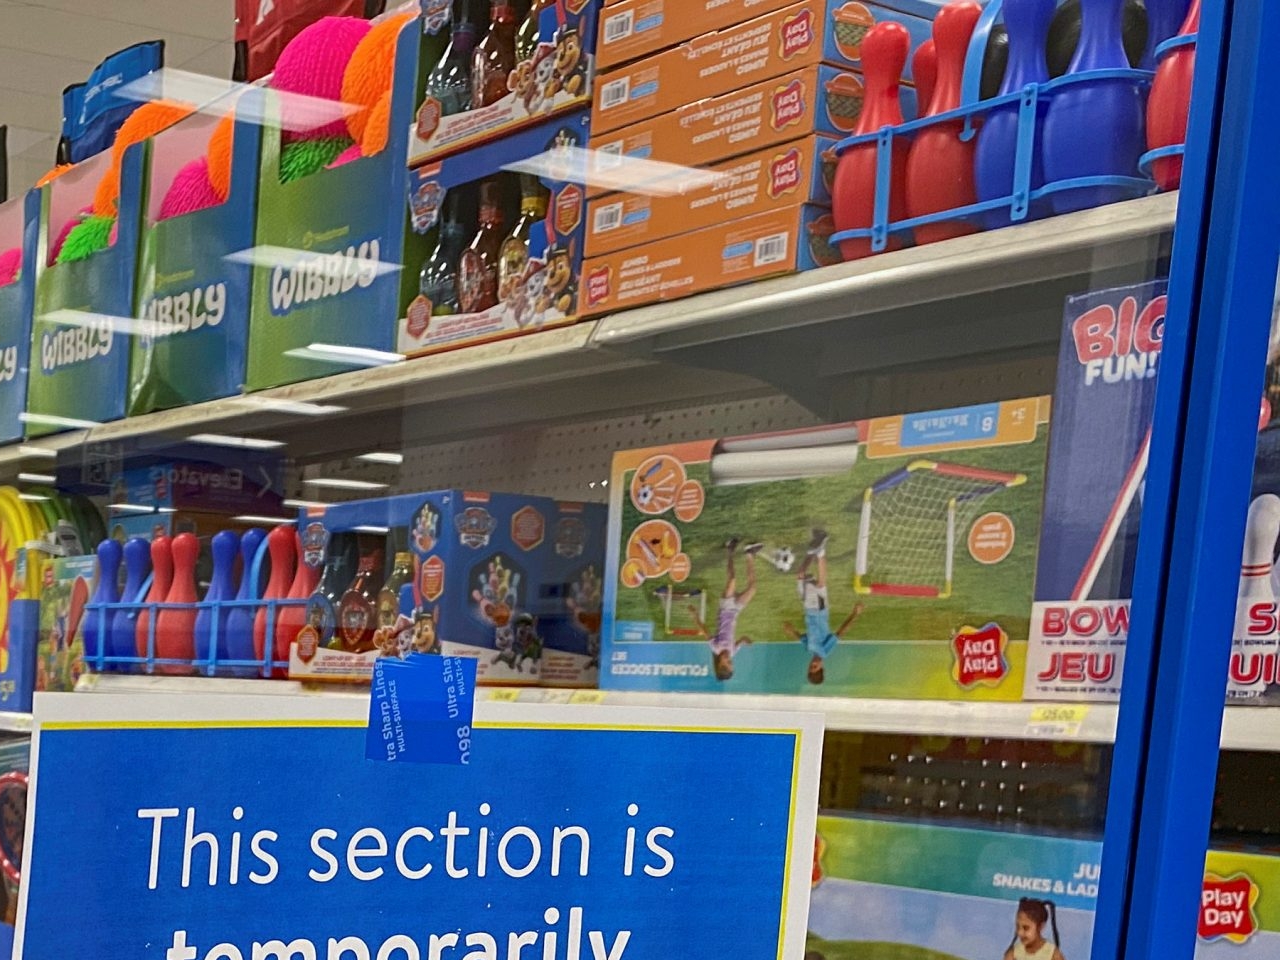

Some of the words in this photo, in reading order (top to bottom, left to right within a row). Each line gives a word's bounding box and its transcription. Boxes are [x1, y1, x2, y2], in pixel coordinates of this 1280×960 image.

[273, 239, 380, 310] WIBBLY
[41, 320, 113, 369] WIBBLY
[1084, 352, 1157, 387] FUN!
[963, 637, 996, 656] Day
[374, 660, 387, 698] Lines
[442, 655, 454, 683] Sha
[963, 655, 999, 675] Play
[1037, 652, 1115, 682] JEU
[388, 679, 406, 752] MULTI-SURFACE
[446, 686, 459, 718] Ultra
[379, 701, 393, 740] Sharp
[137, 805, 278, 891] This
[309, 803, 590, 883] section
[622, 803, 676, 879] is
[992, 873, 1052, 894] SNAKES
[1053, 880, 1065, 893] &
[1202, 889, 1245, 911] Play
[1205, 909, 1244, 928] Day
